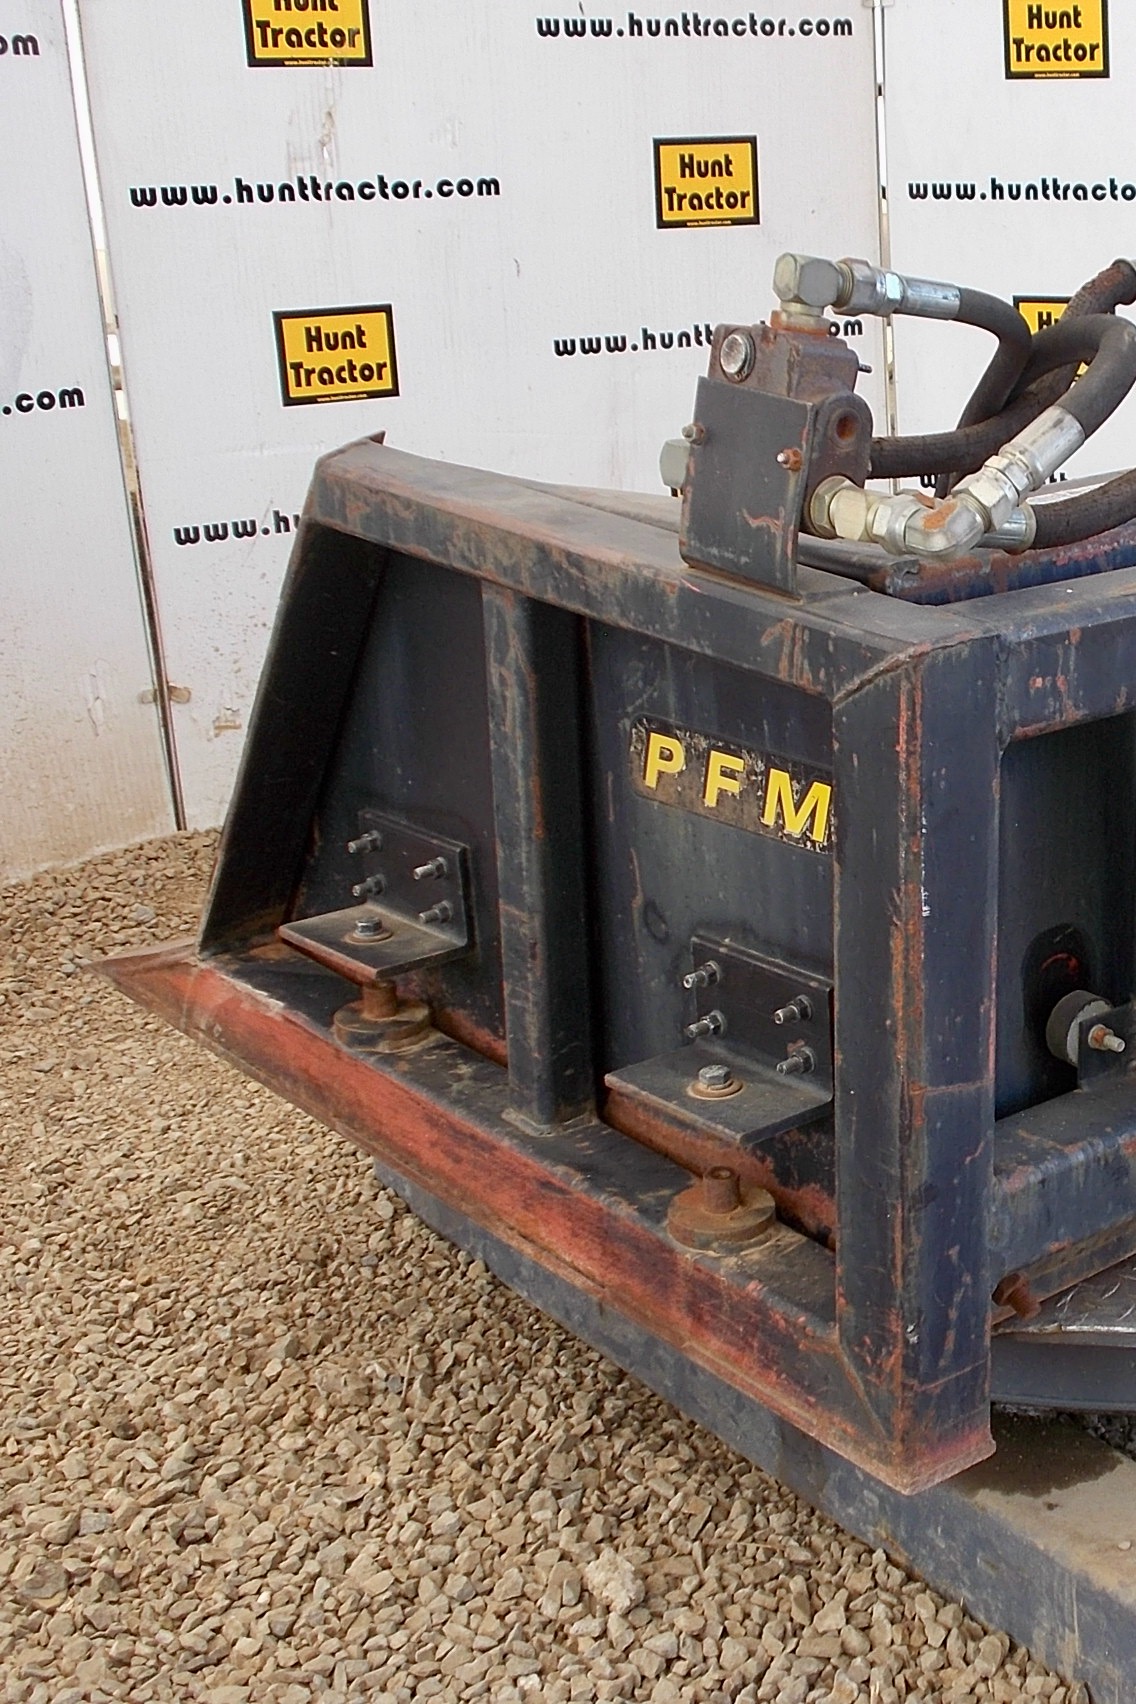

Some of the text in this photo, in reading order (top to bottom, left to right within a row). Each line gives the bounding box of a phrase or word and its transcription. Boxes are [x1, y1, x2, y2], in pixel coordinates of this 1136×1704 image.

[536, 12, 853, 38] www.hunttractor.com
[1027, 3, 1082, 30] Hunt
[256, 19, 361, 49] Tractor
[1012, 37, 1100, 63] Tractor
[678, 153, 734, 179] Hunt
[129, 174, 501, 208] www.hunttractor.com
[663, 186, 751, 212] Tractor
[304, 324, 367, 353] Hunt
[289, 358, 388, 388] Tractor
[645, 732, 832, 842] PFM
